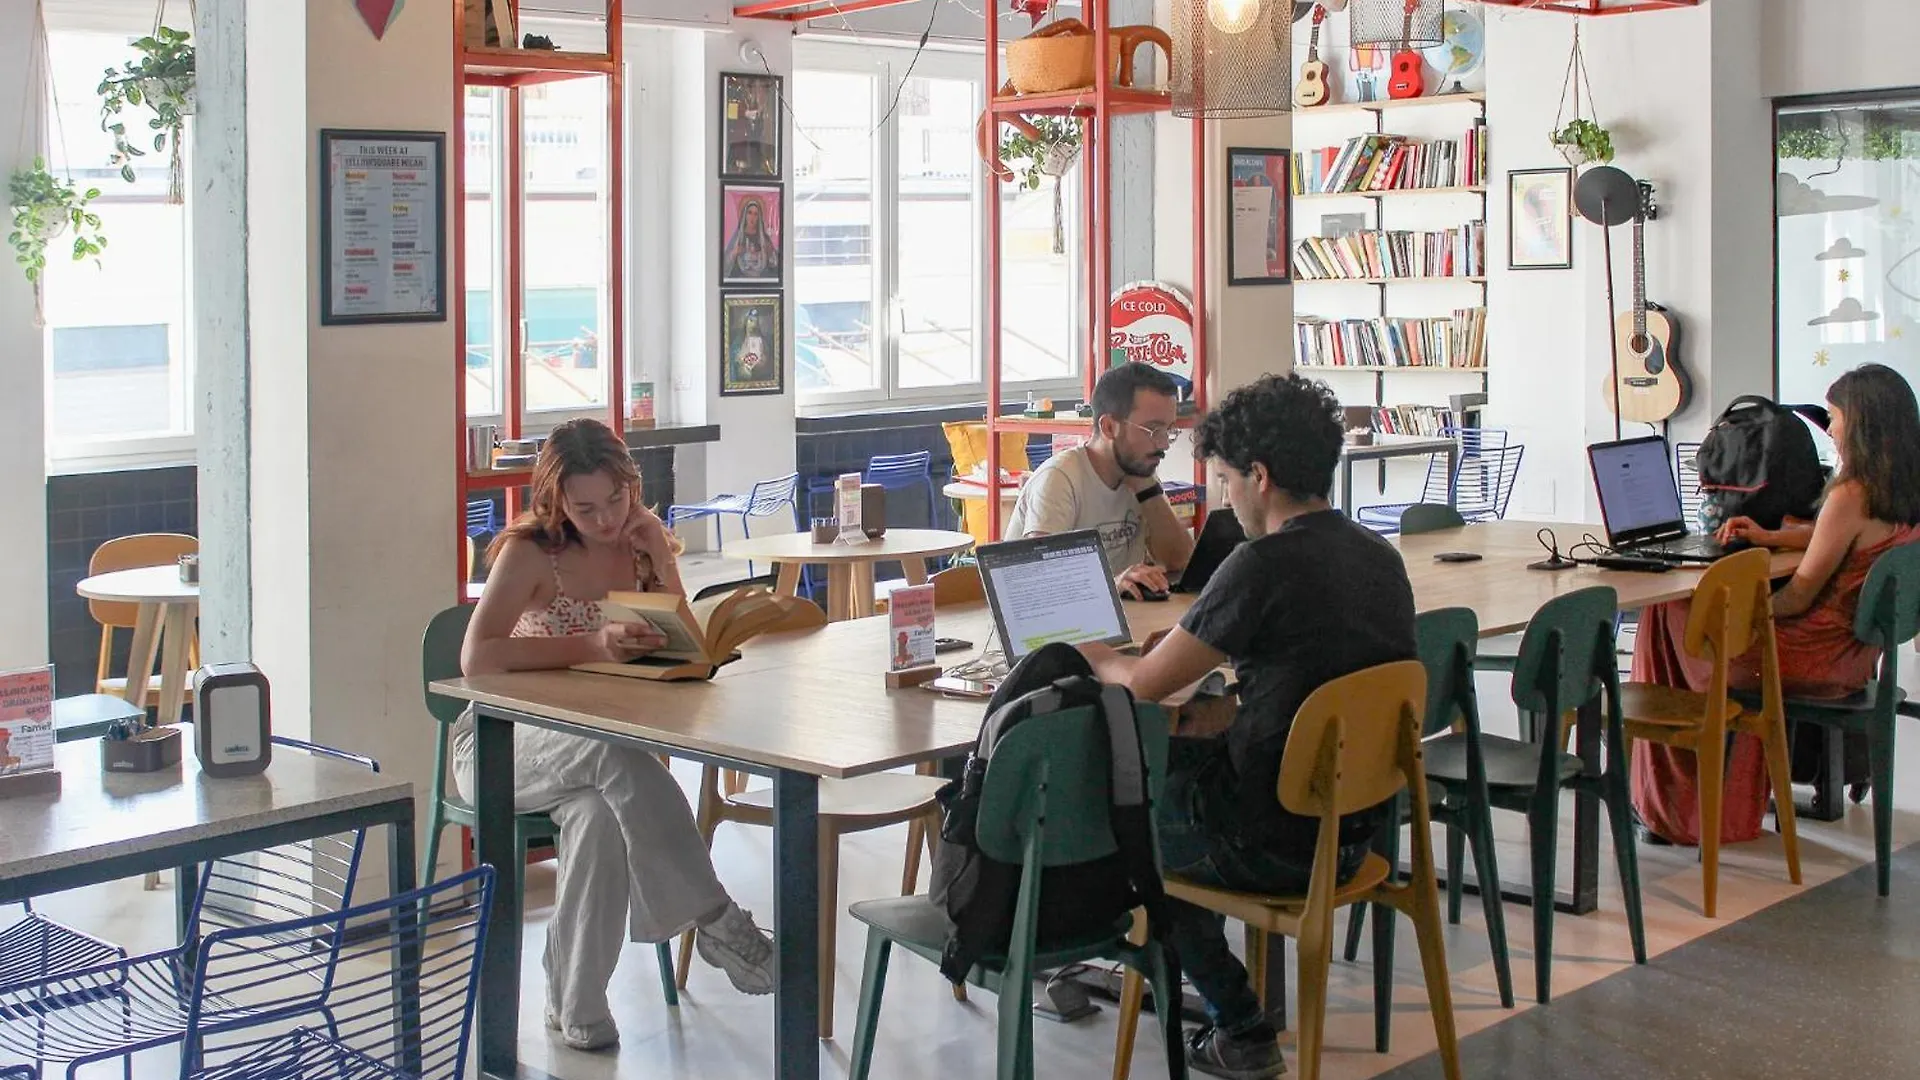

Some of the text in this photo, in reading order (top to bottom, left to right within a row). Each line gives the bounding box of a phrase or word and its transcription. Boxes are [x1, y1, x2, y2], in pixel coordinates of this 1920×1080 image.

[360, 146, 376, 154] THIS
[377, 146, 398, 155] WEEK
[1120, 301, 1166, 313] ICE COLD
